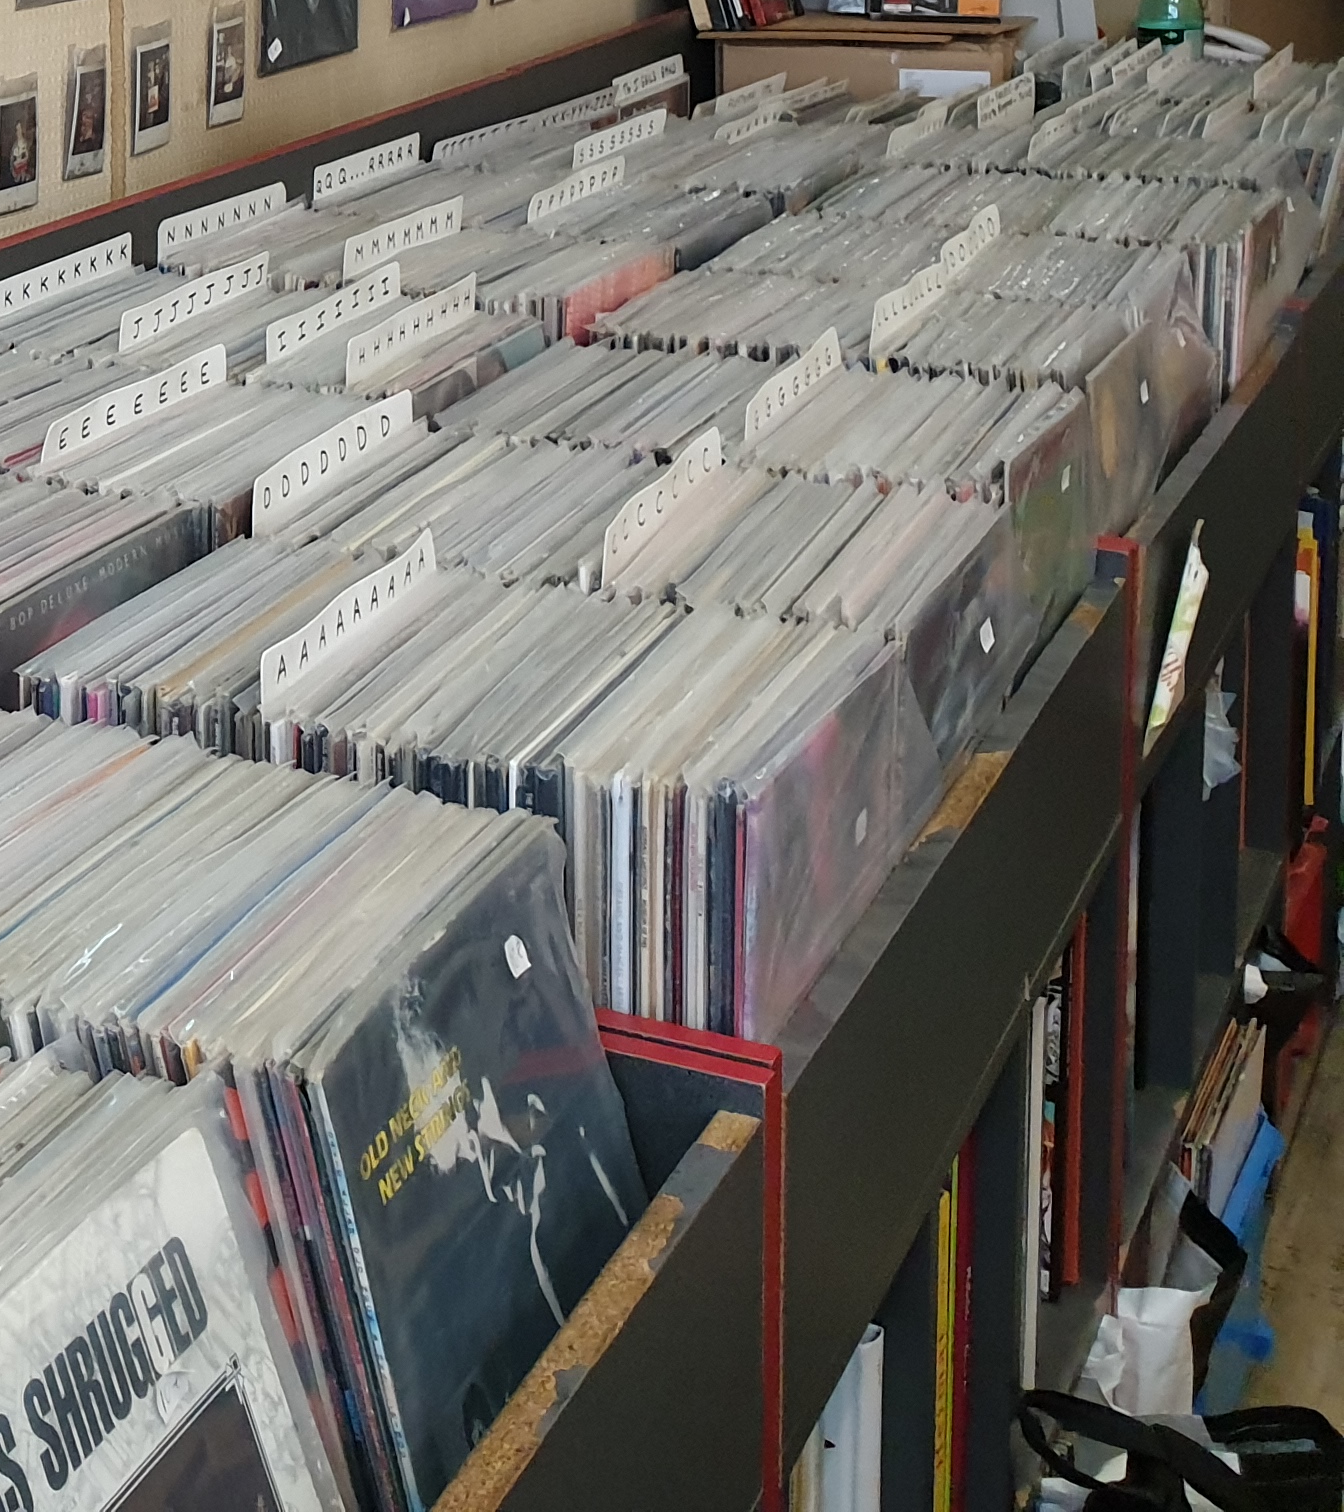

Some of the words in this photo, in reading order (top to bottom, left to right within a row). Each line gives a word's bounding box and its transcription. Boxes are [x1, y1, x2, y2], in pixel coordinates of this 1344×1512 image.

[360, 1131, 389, 1181] OLD
[378, 1149, 415, 1206] NEW
[22, 1236, 208, 1491] SHRUGGED
